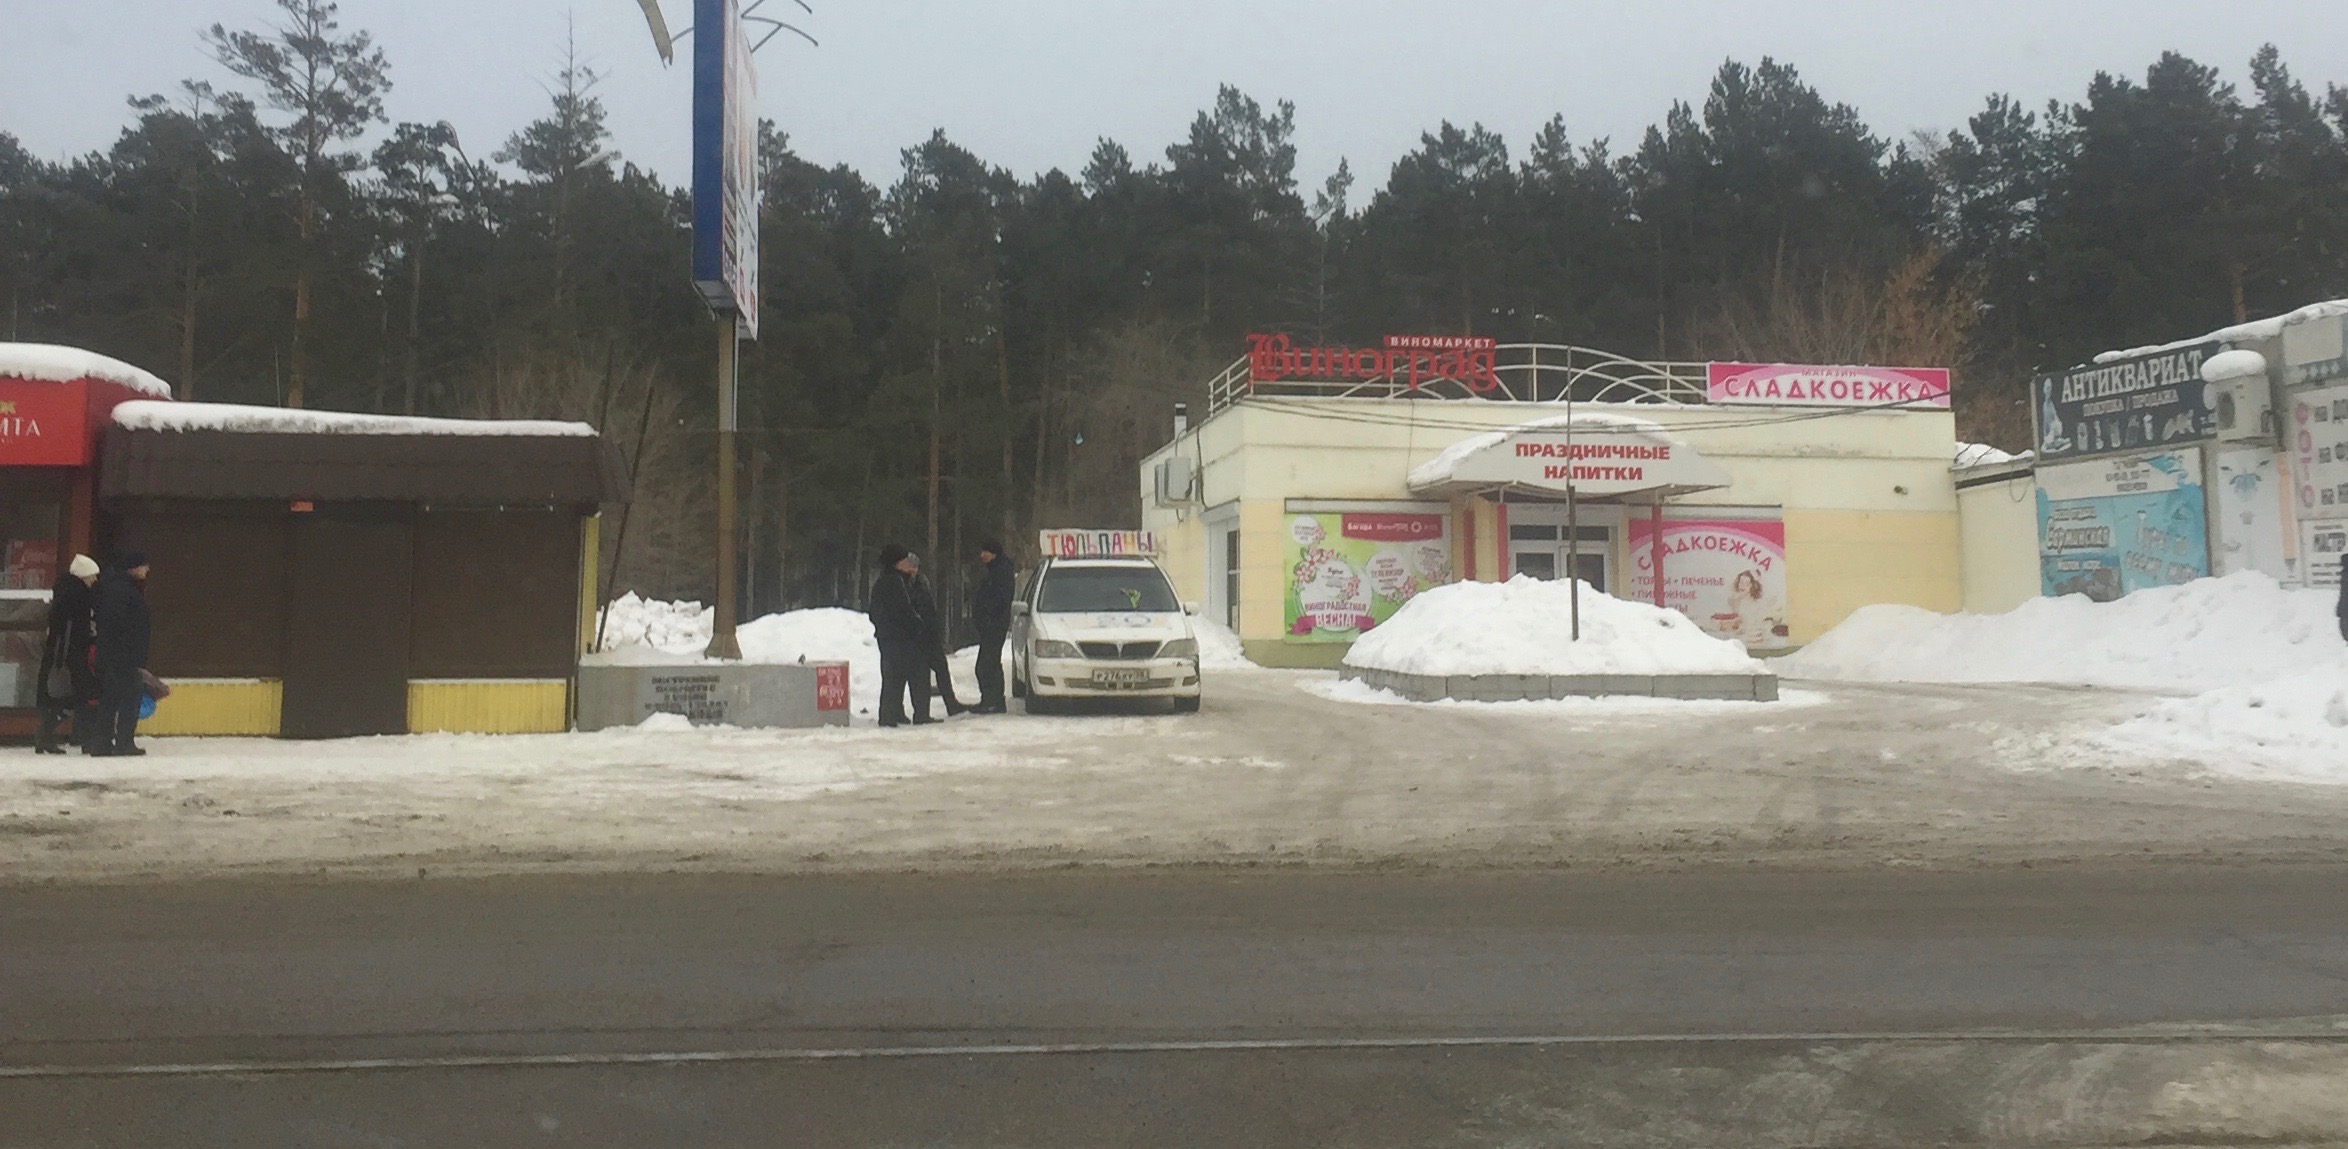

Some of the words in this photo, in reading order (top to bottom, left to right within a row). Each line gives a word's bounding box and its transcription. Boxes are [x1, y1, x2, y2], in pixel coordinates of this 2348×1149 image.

[1390, 337, 1491, 348] ВИНОМАРКЕТ
[1246, 334, 1497, 391] Виноград
[2061, 349, 2202, 403] АНТИКВАРИАТ
[1724, 378, 1934, 400] СЛАДКОЕЖКА
[1515, 443, 1671, 460] ПРАЗДНИЧНЫЕ
[1544, 466, 1643, 480] НАПИТКИ
[1047, 532, 1152, 558] ТЮЛЬПАНЫ
[1638, 535, 1772, 571] САДКОЕЖКА
[1637, 590, 1696, 599] ПИЖНЫЕ
